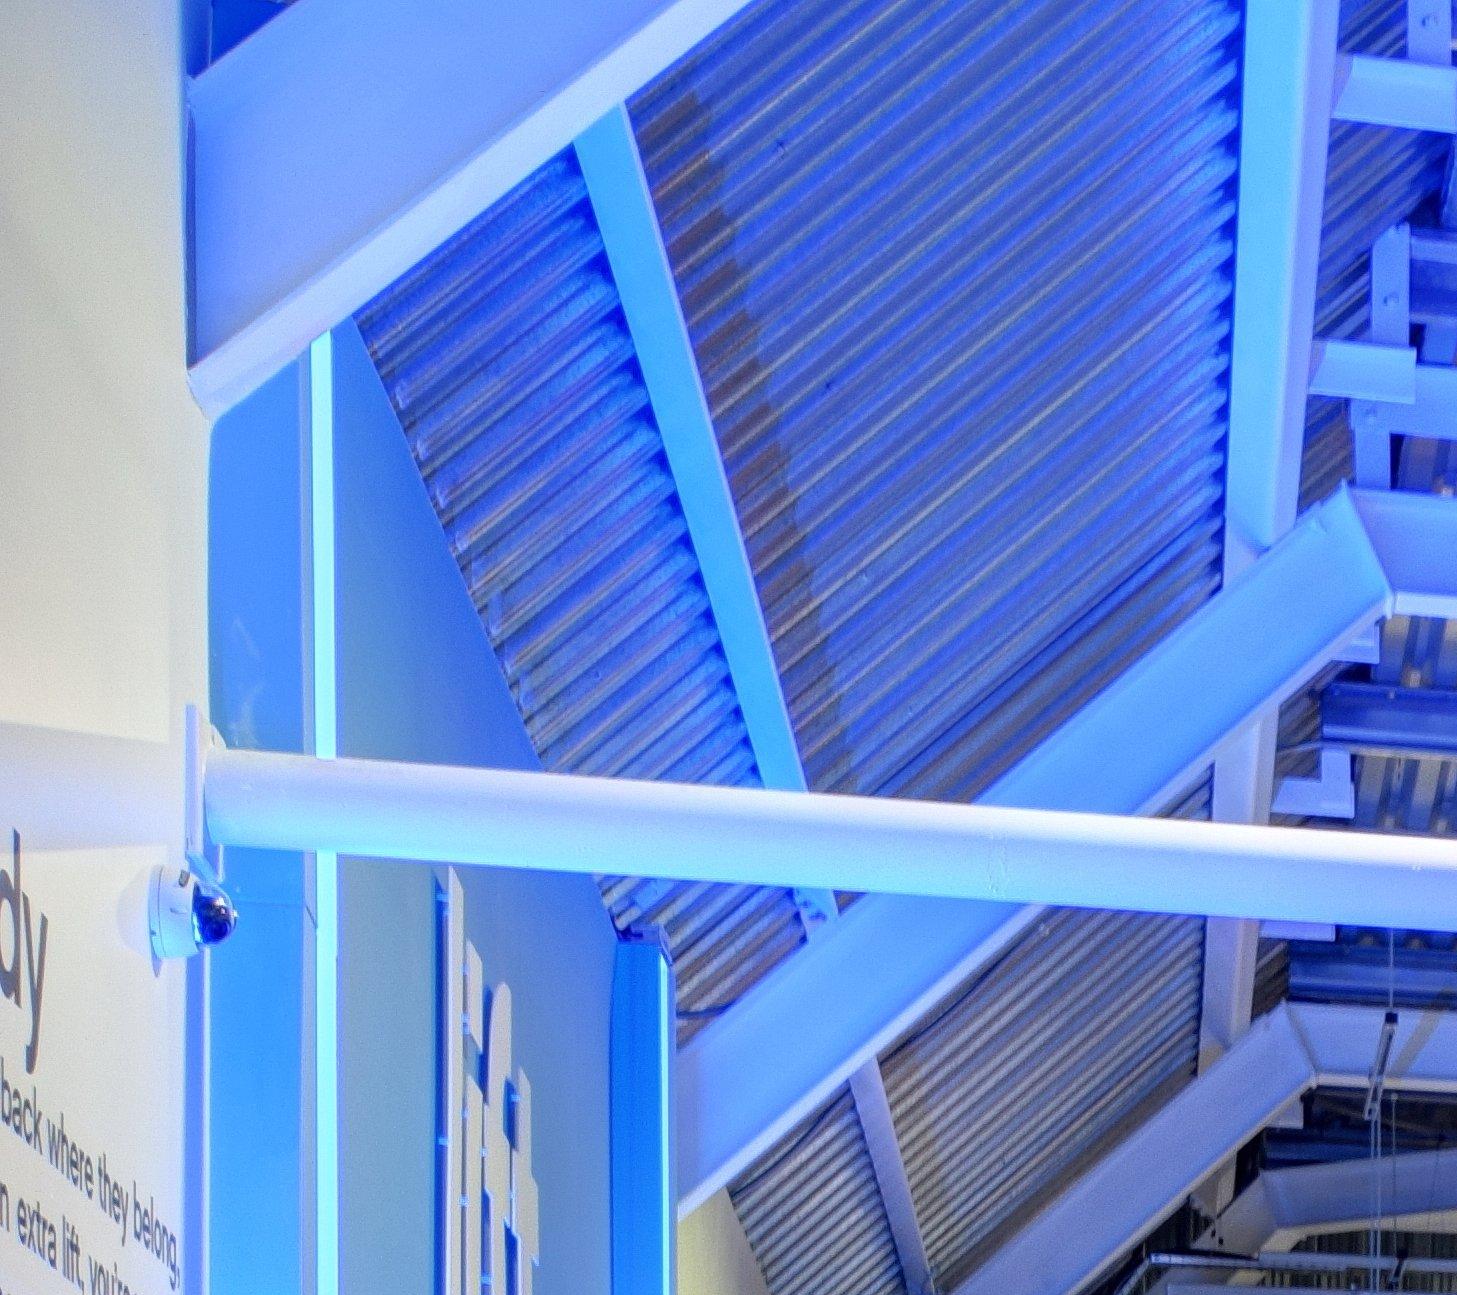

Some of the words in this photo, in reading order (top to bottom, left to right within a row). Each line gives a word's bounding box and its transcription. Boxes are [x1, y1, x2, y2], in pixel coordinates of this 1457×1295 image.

[17, 1200, 57, 1271] extra
[47, 1112, 93, 1200] where
[98, 1156, 129, 1246] they
[133, 1180, 180, 1289] belong,
